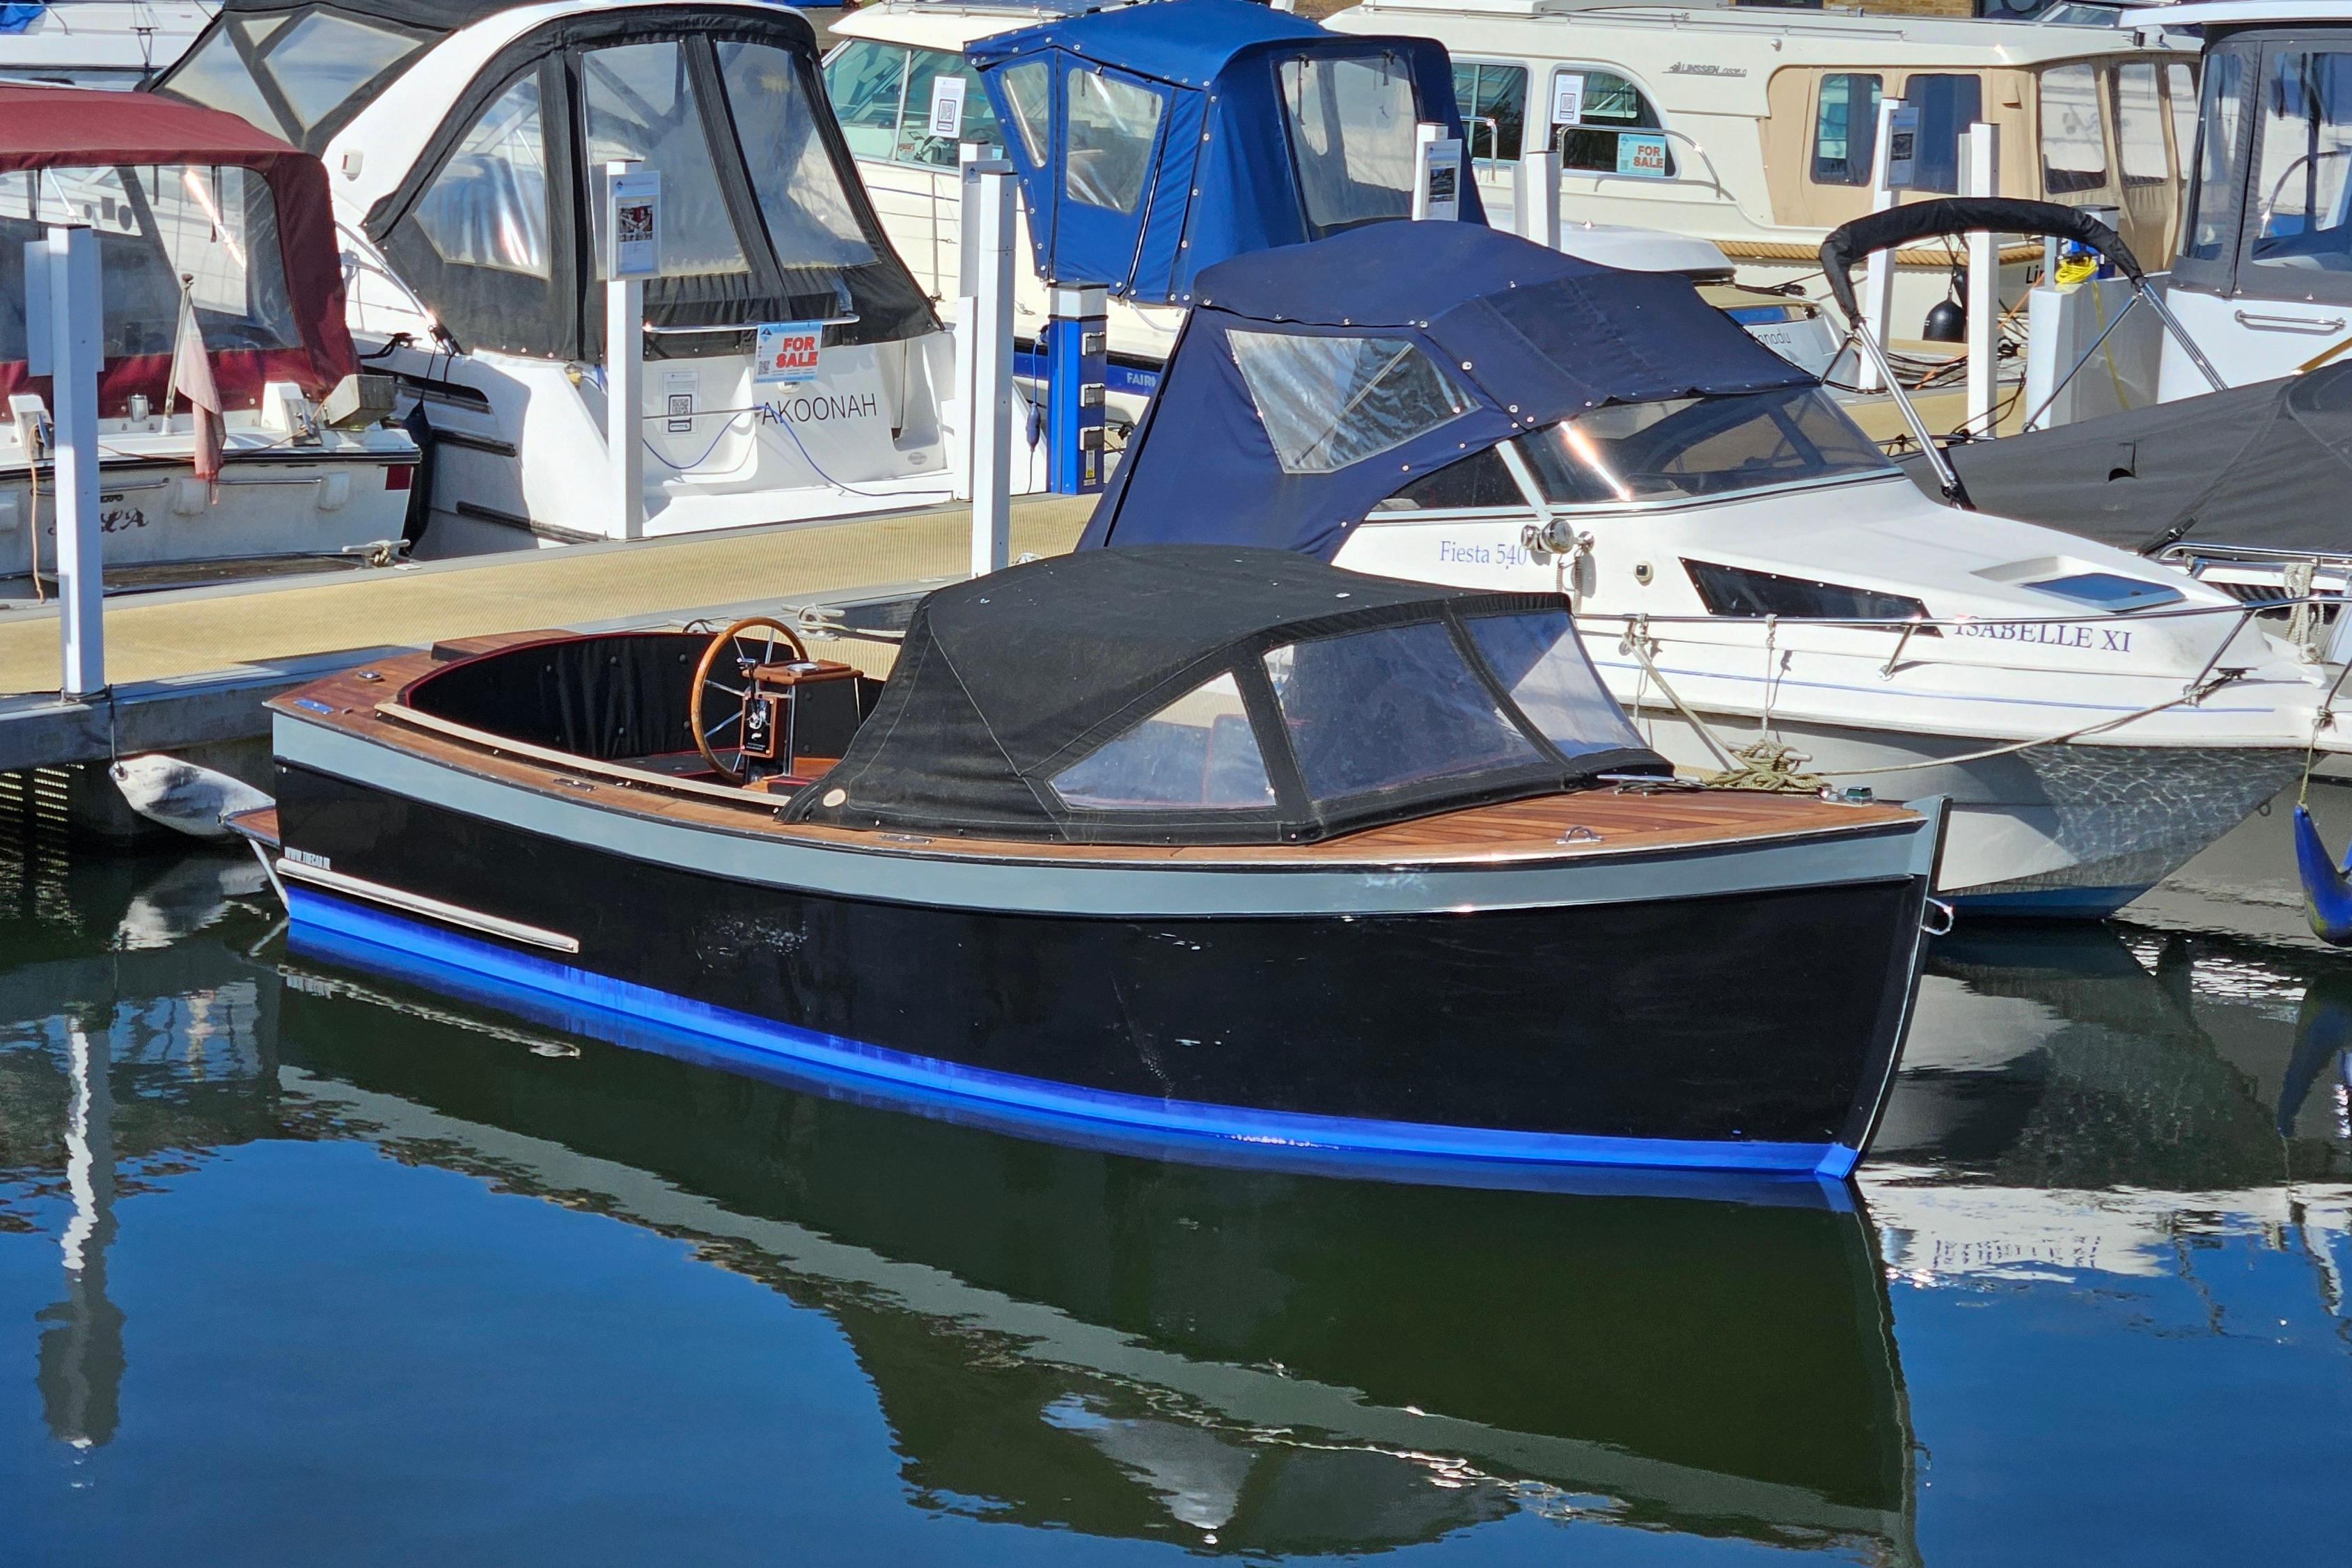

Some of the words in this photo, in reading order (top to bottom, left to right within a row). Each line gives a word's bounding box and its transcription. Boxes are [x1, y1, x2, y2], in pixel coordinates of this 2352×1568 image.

[1637, 145, 1661, 157] FOR
[1633, 156, 1663, 168] SALE
[783, 336, 815, 352] FOR
[1751, 329, 1792, 345] anadu
[776, 351, 819, 368] SALE
[762, 393, 877, 425] AKOONAH
[1439, 540, 1490, 563] Fiesta
[1496, 543, 1528, 565] 540
[1954, 616, 2094, 649] ISABELLE
[2100, 629, 2133, 653] XI
